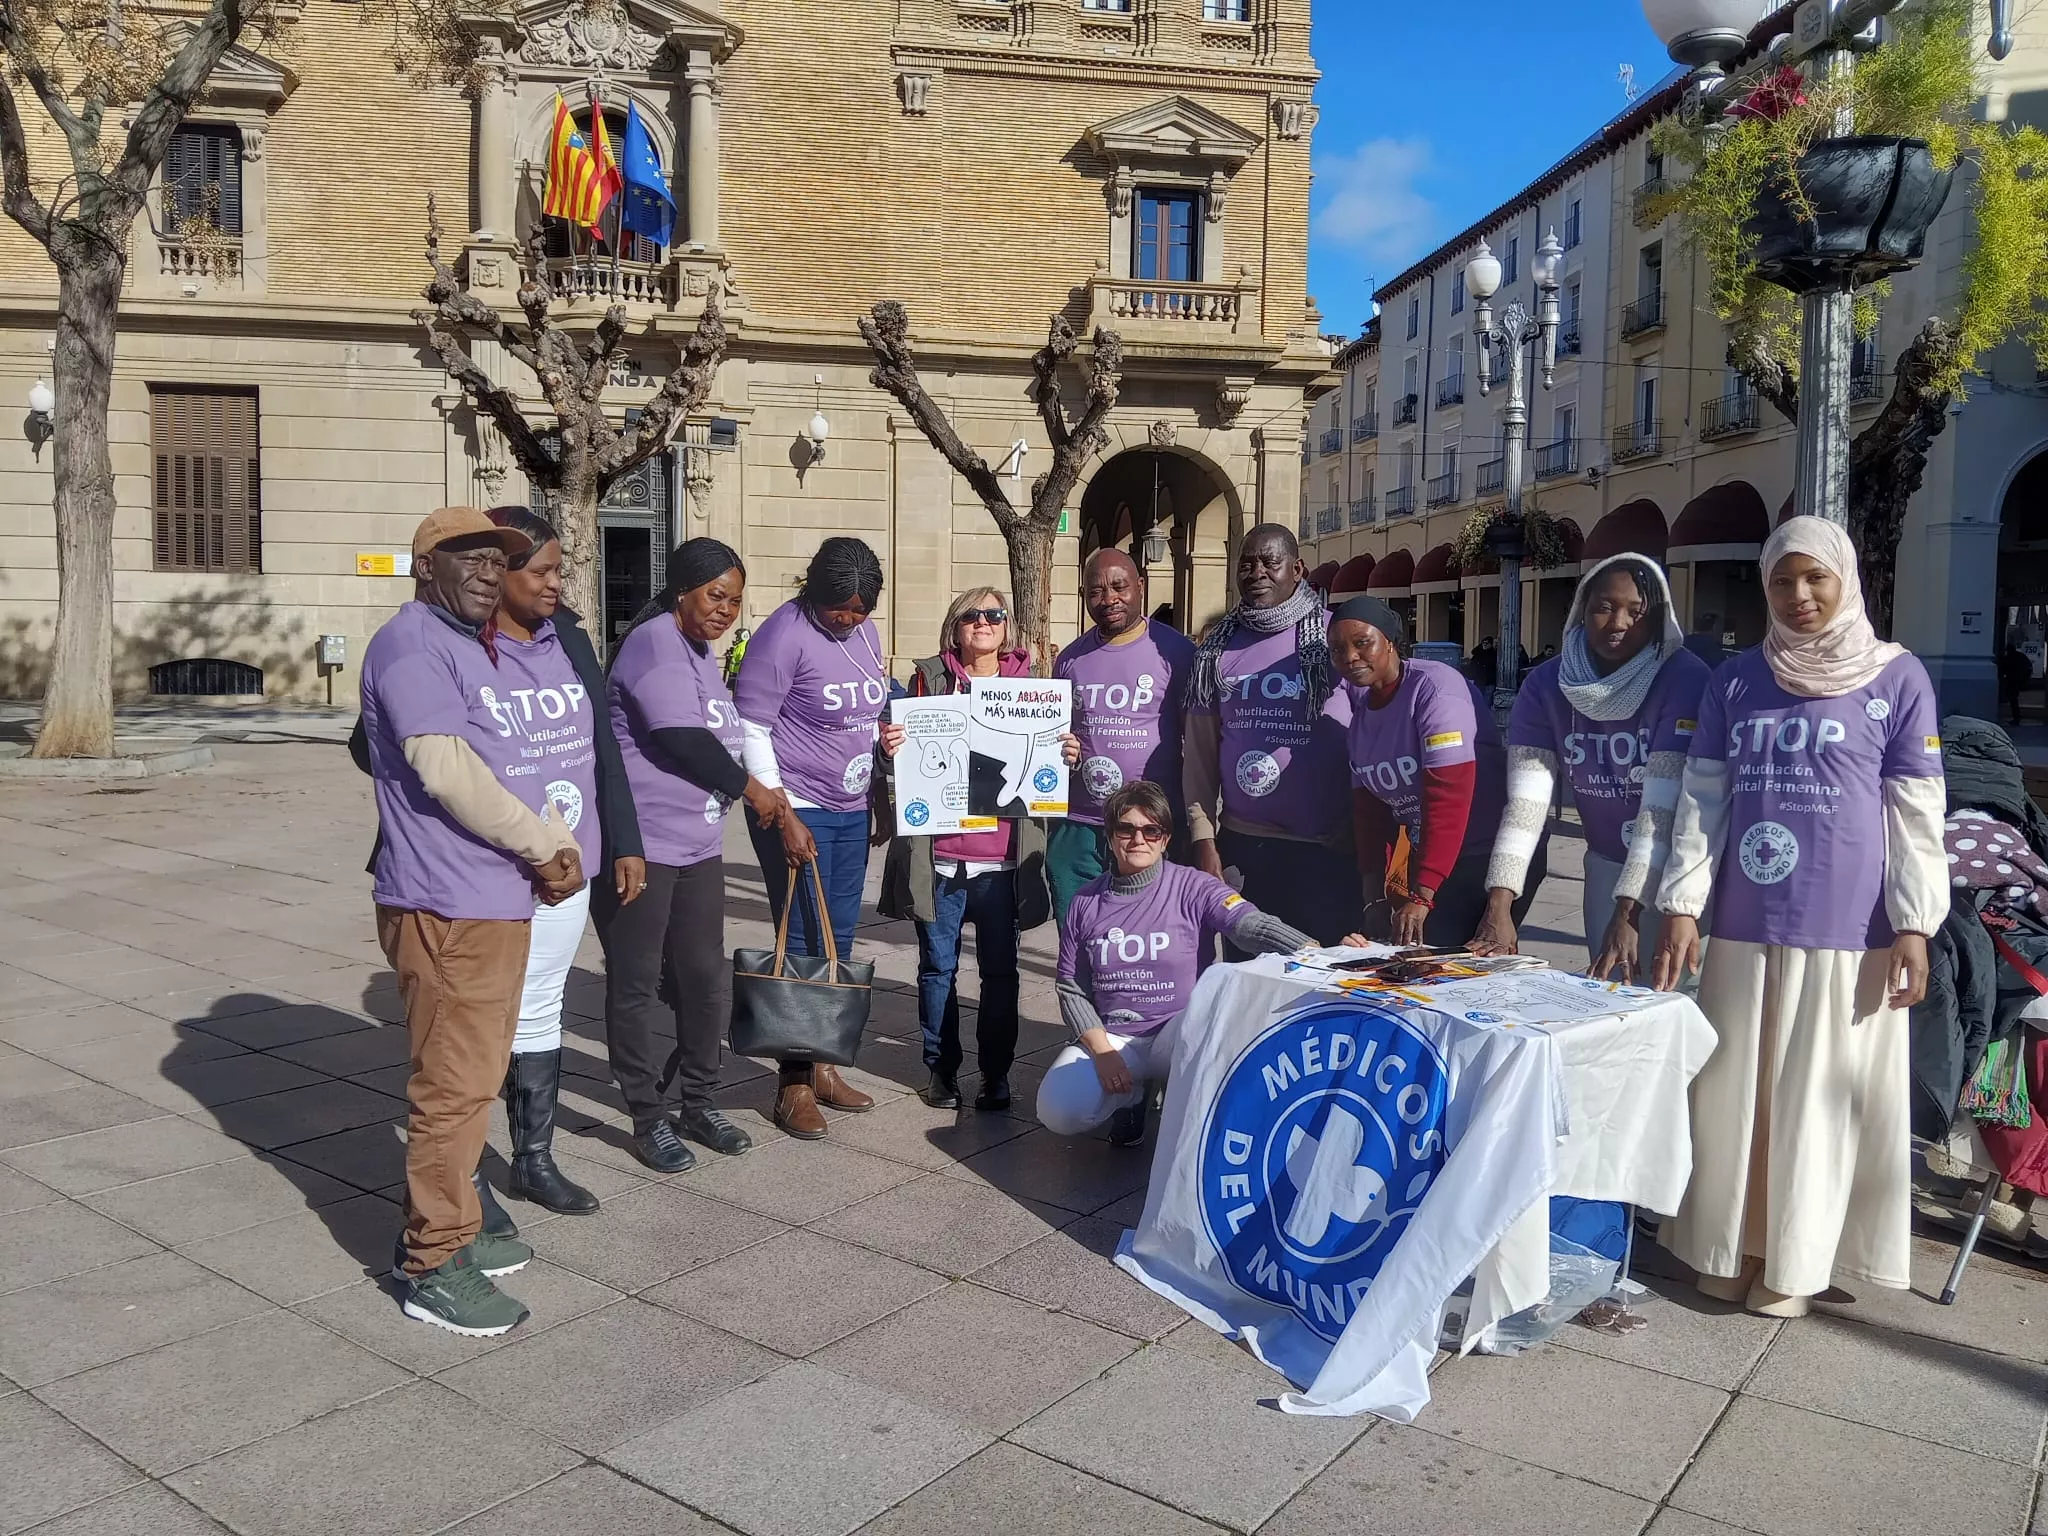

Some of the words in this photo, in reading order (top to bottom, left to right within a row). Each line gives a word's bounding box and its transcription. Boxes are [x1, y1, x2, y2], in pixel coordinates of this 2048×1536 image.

[823, 677, 887, 711] STO
[981, 690, 1012, 702] MENOS
[510, 683, 585, 721] TOP
[985, 703, 1005, 719] MÁS
[1234, 706, 1292, 717] Mutilación
[528, 725, 577, 742] utilación
[1098, 728, 1148, 737] Femenina
[1254, 720, 1312, 732] Femenina
[1265, 735, 1312, 746] #StopMGF
[1729, 716, 1845, 758] STOP
[1107, 741, 1149, 750] #StopMGF
[1349, 755, 1418, 793] TOP
[1738, 763, 1815, 777] Mutilación
[1764, 780, 1841, 796] Femenina
[1779, 801, 1840, 815] #StopMGF
[1742, 854, 1753, 874] DEL
[1755, 860, 1791, 881] MUNDO
[1118, 980, 1175, 992] Femenina
[1131, 994, 1176, 1005] #StopMGF
[1261, 1026, 1442, 1161] MÉDICOS
[1220, 1128, 1257, 1236] DEL
[1246, 1244, 1377, 1326] MUND
